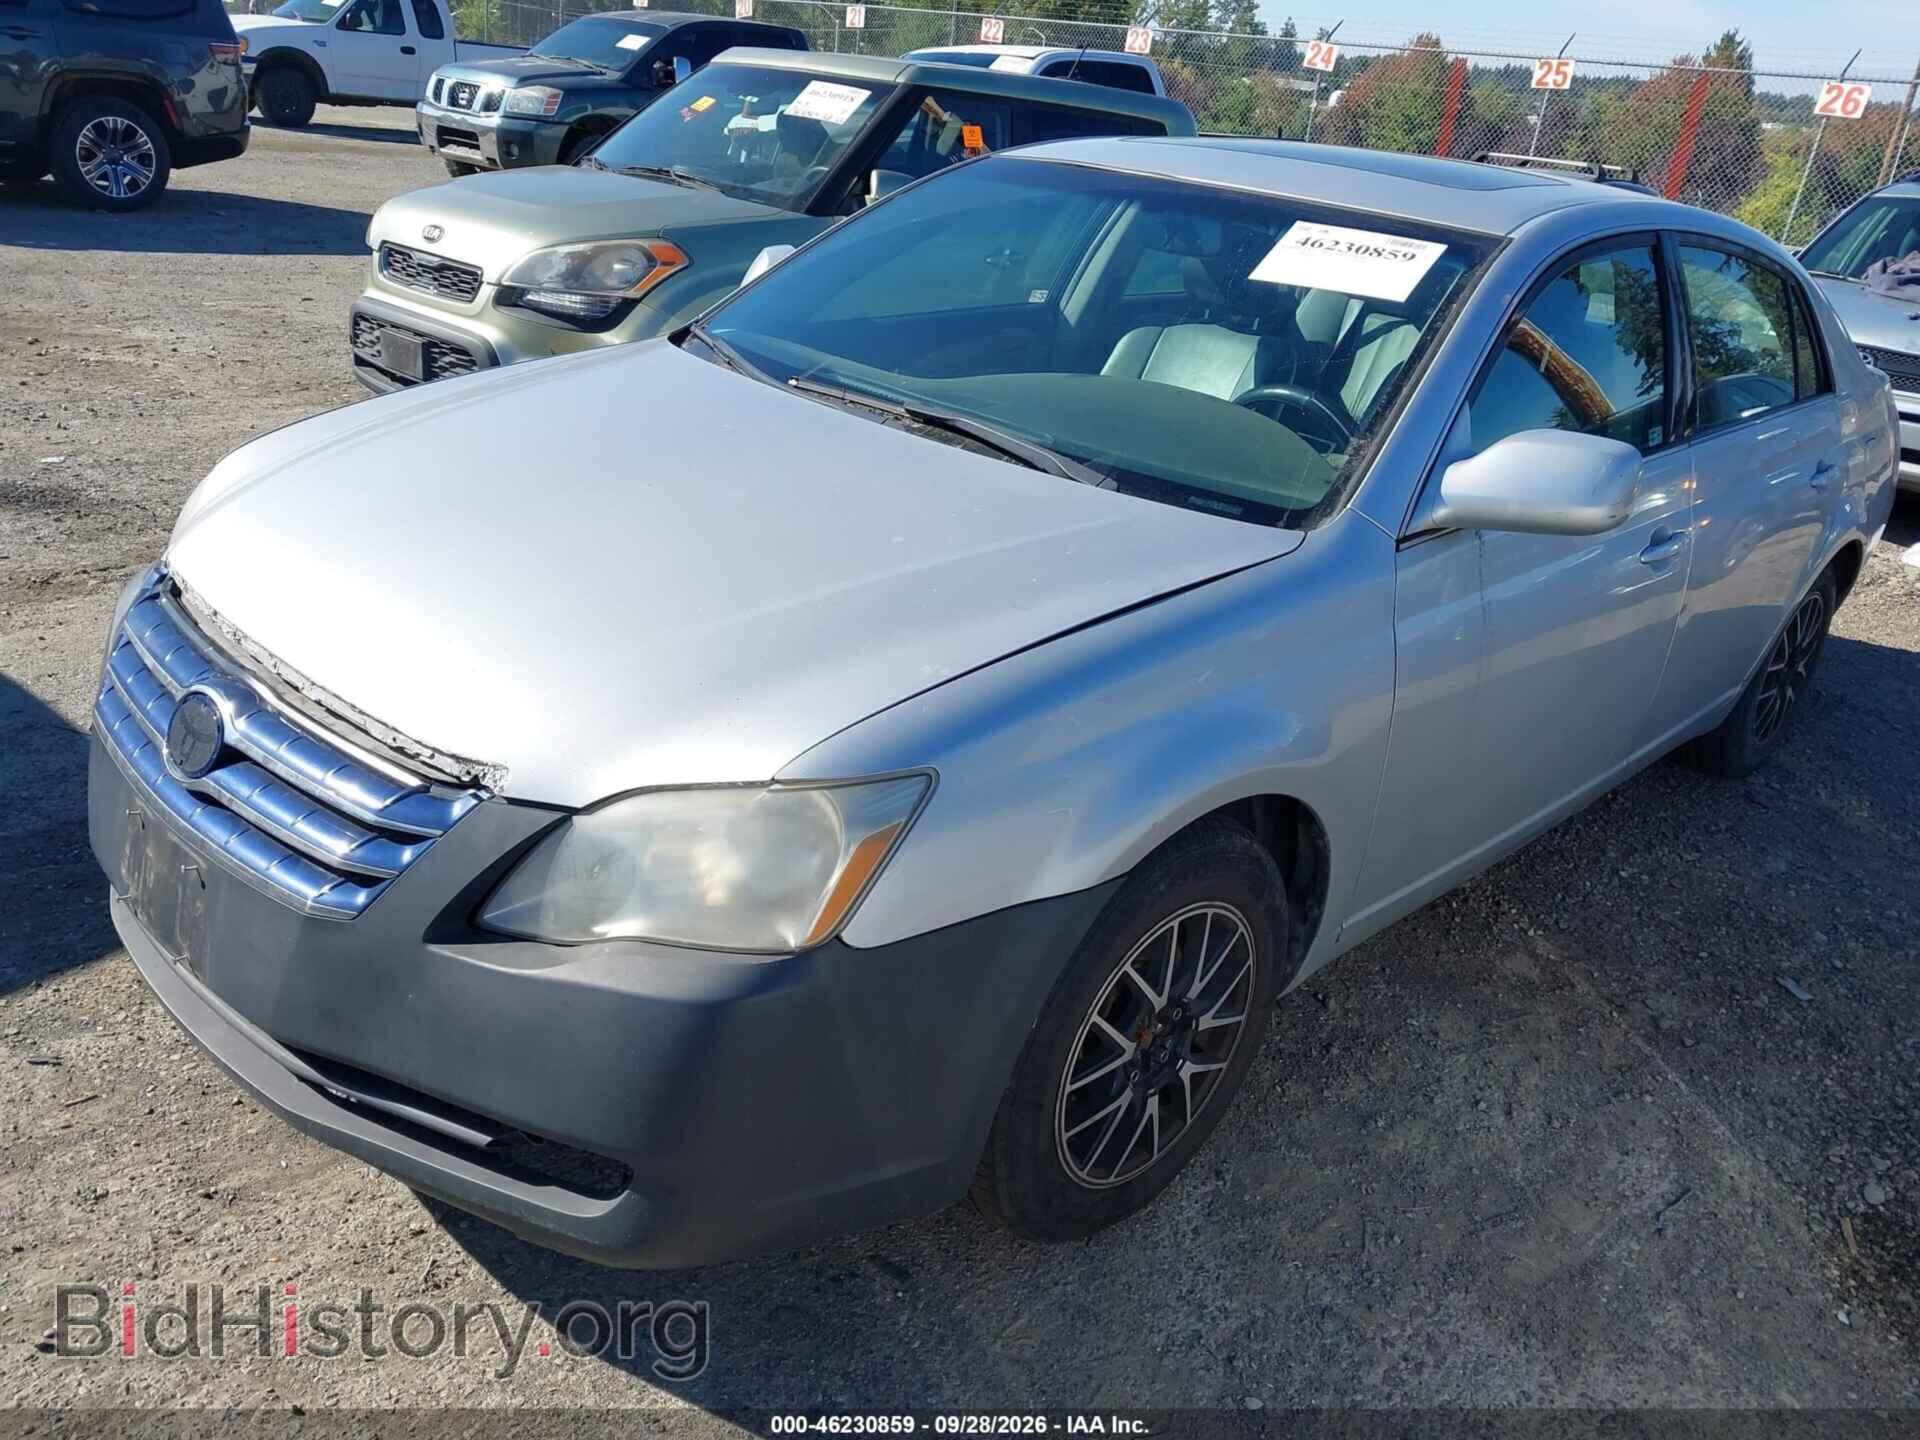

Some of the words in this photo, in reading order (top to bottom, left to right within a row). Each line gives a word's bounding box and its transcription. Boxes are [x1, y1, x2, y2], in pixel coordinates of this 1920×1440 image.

[849, 7, 861, 26] 21
[983, 21, 1001, 41] 22
[1127, 29, 1150, 51] 23
[1306, 43, 1334, 69] 24
[1535, 60, 1569, 87] 25
[1818, 84, 1864, 116] 26
[1295, 235, 1417, 262] 46230859
